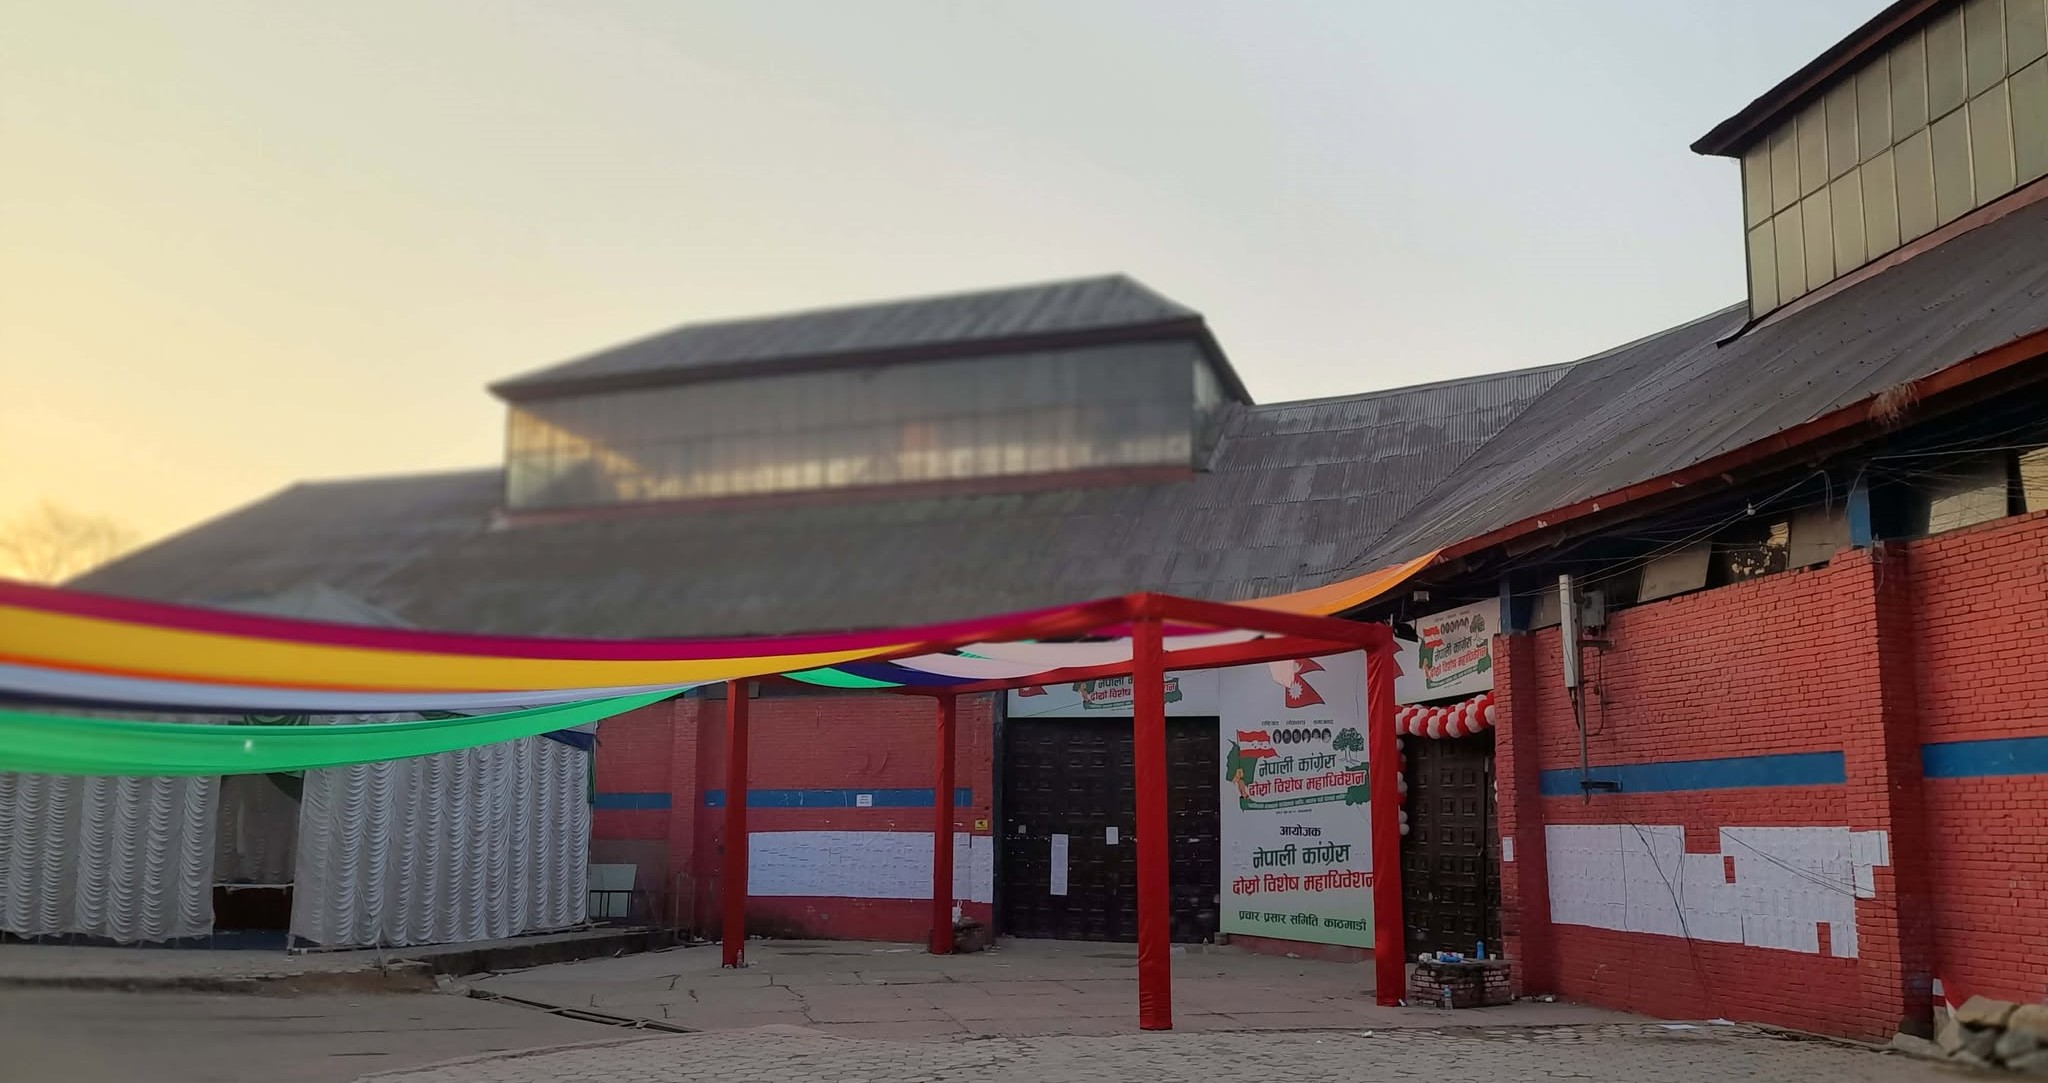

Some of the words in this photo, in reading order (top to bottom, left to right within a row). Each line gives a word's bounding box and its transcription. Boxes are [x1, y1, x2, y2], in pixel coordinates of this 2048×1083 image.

[1258, 756, 1294, 778] नेपाली
[1298, 752, 1337, 773] कांग्रेस
[1274, 776, 1304, 793] विशेष
[1306, 771, 1365, 791] महाधिवेशन
[1279, 824, 1322, 837] आयोजक
[1253, 844, 1297, 869] नेपाली
[1302, 841, 1352, 866] कांग्रेस
[1264, 872, 1300, 893] विशेष
[1238, 910, 1260, 922] प्रचार
[1263, 911, 1287, 924] प्रसार
